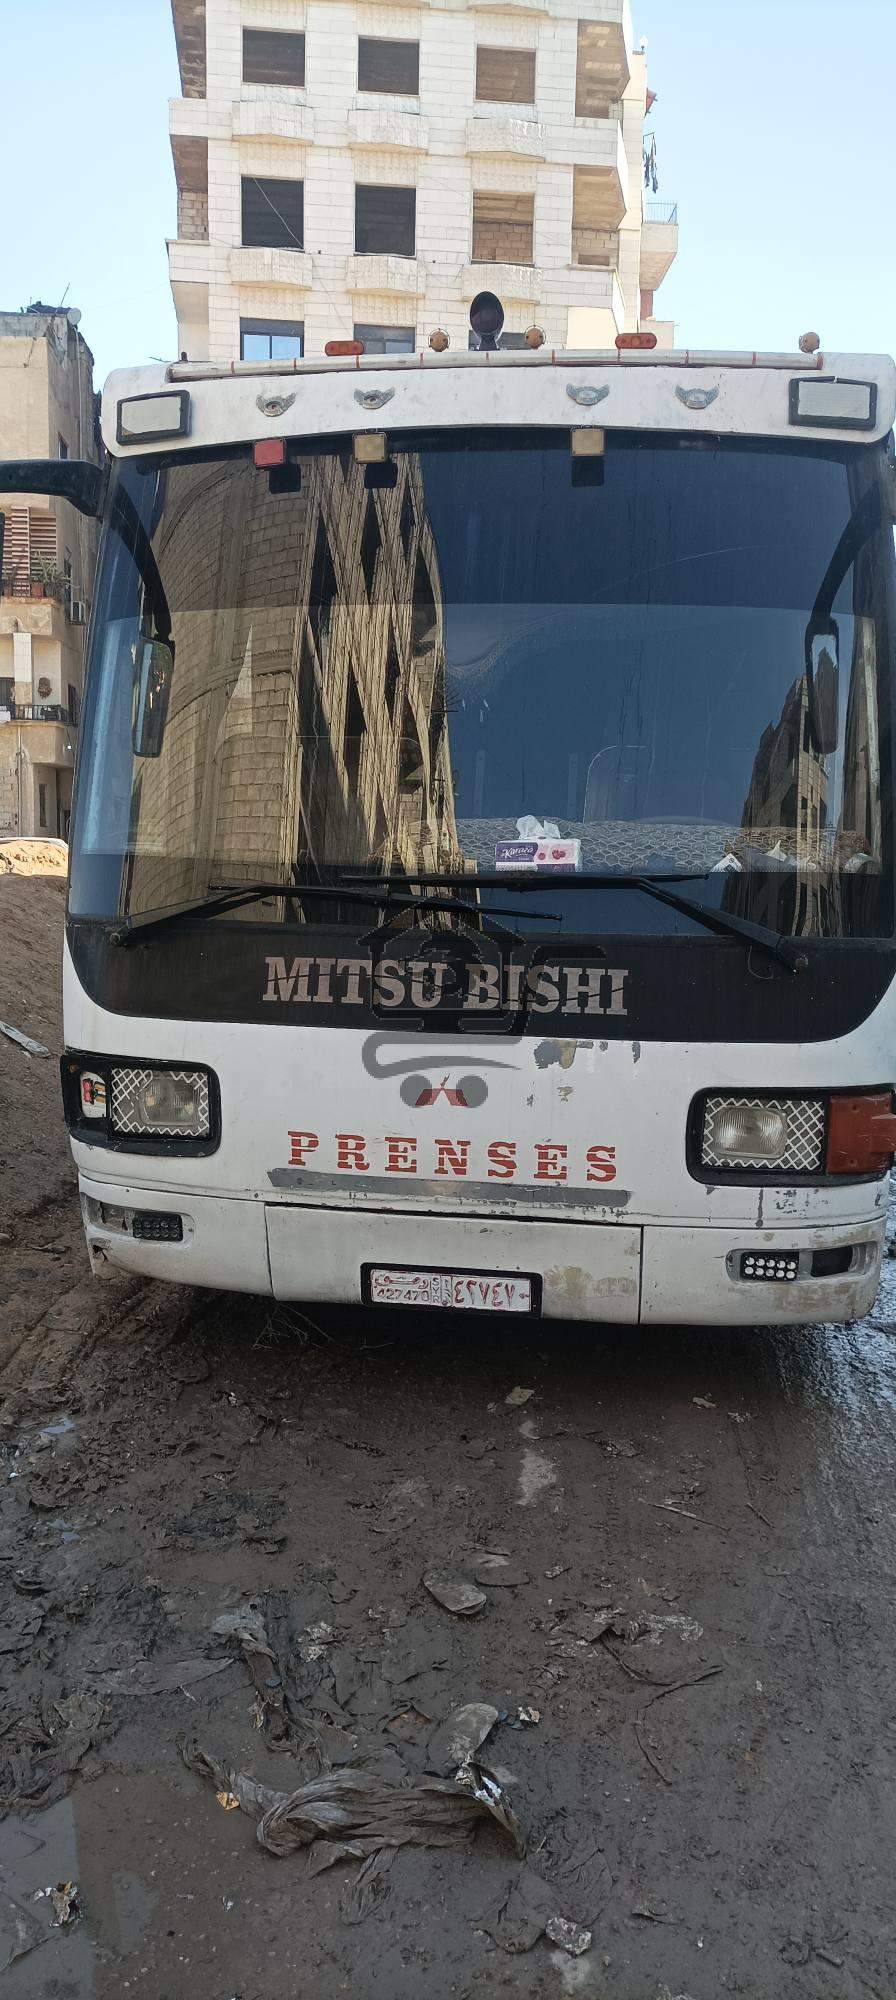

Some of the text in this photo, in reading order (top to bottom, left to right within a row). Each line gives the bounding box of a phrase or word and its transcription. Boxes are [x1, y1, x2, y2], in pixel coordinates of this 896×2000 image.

[262, 957, 629, 1016] MITSU BISHI
[287, 1130, 617, 1183] PRENSES
